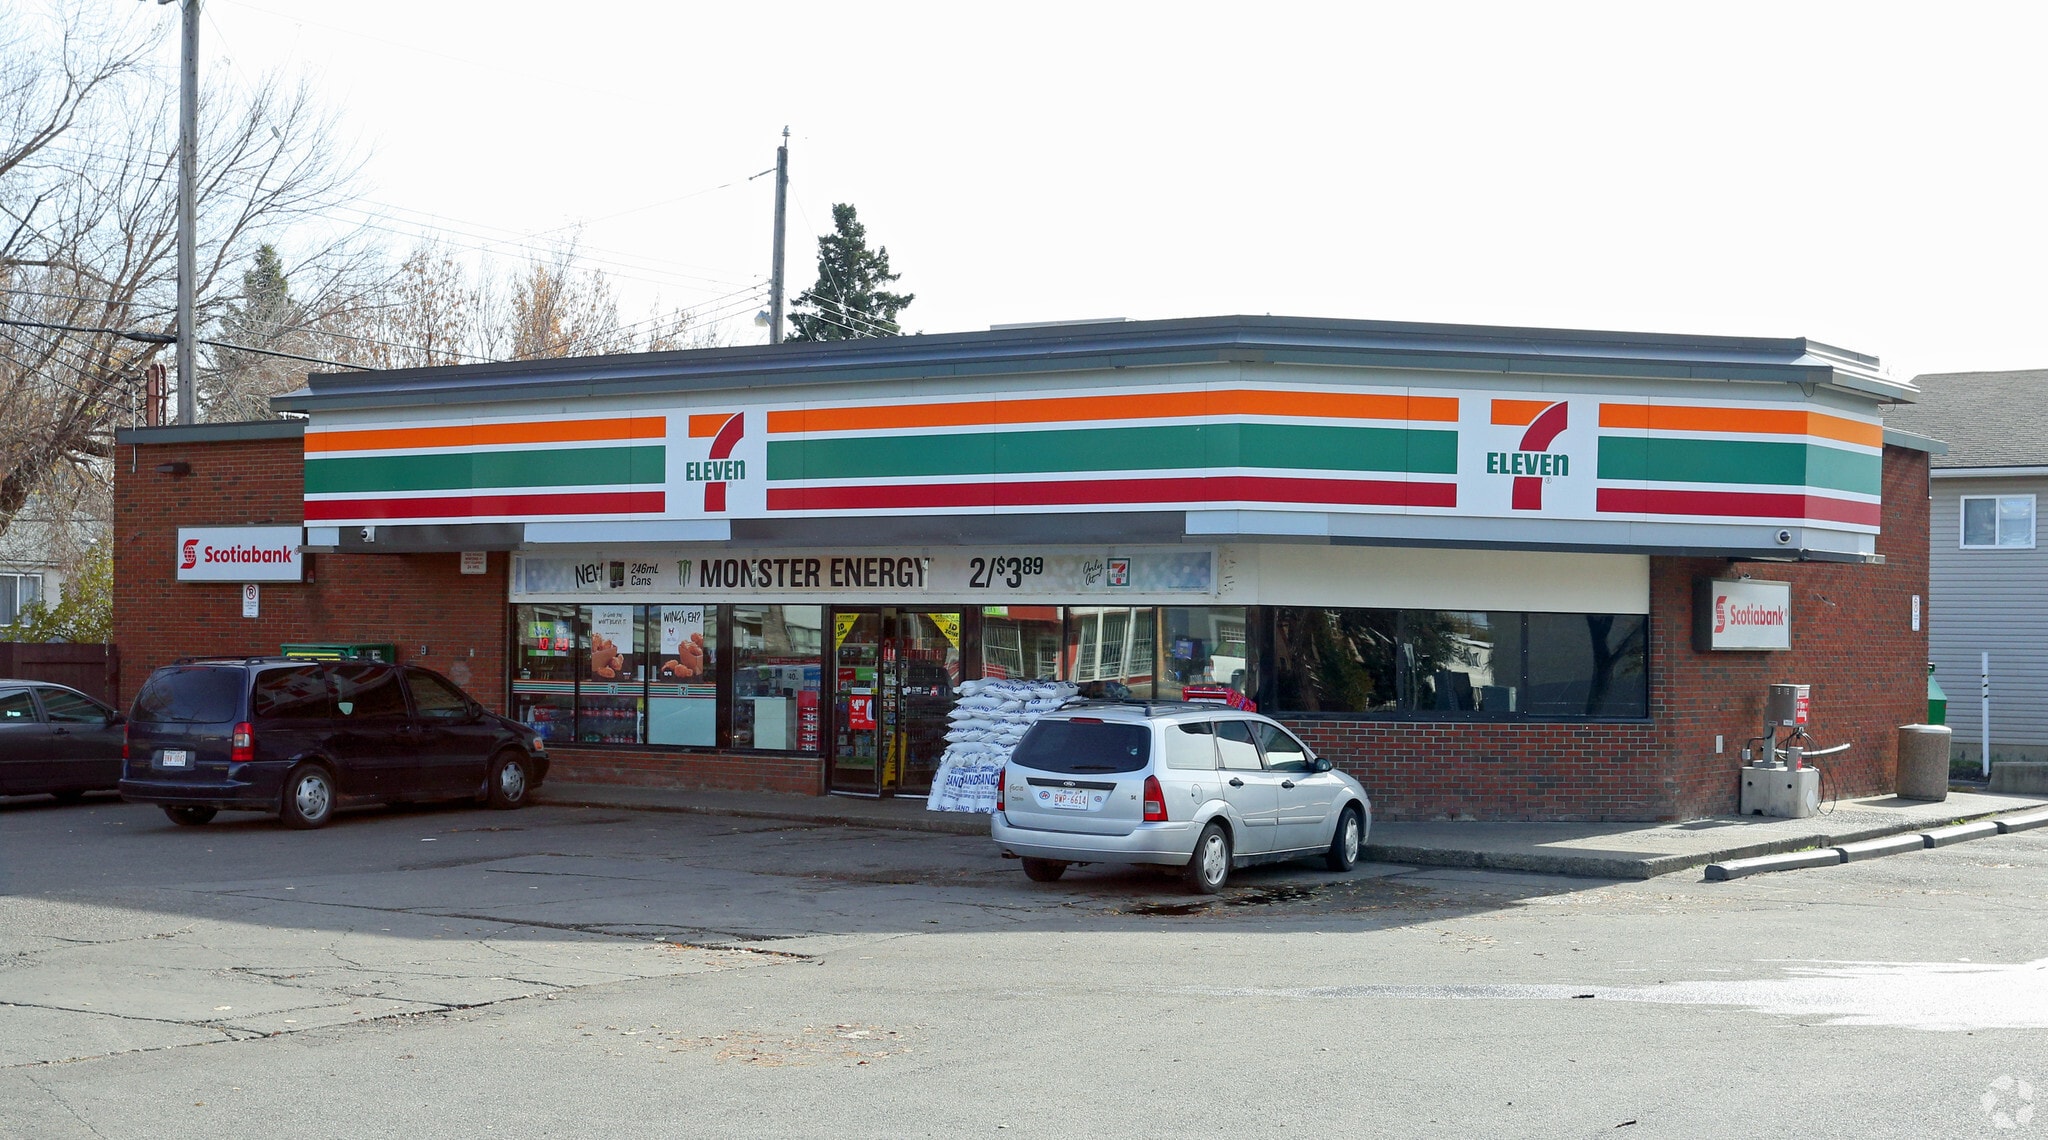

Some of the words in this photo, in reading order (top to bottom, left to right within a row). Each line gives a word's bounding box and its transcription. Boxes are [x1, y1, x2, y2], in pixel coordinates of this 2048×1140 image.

[204, 544, 292, 563] Scotiabank
[630, 563, 659, 575] 246mL
[699, 558, 821, 588] MONSTER
[830, 557, 930, 588] ENERGY
[630, 575, 652, 586] Cans
[663, 610, 687, 625] WINGS,
[687, 611, 701, 624] EH?
[1730, 603, 1784, 625] Scotiabank
